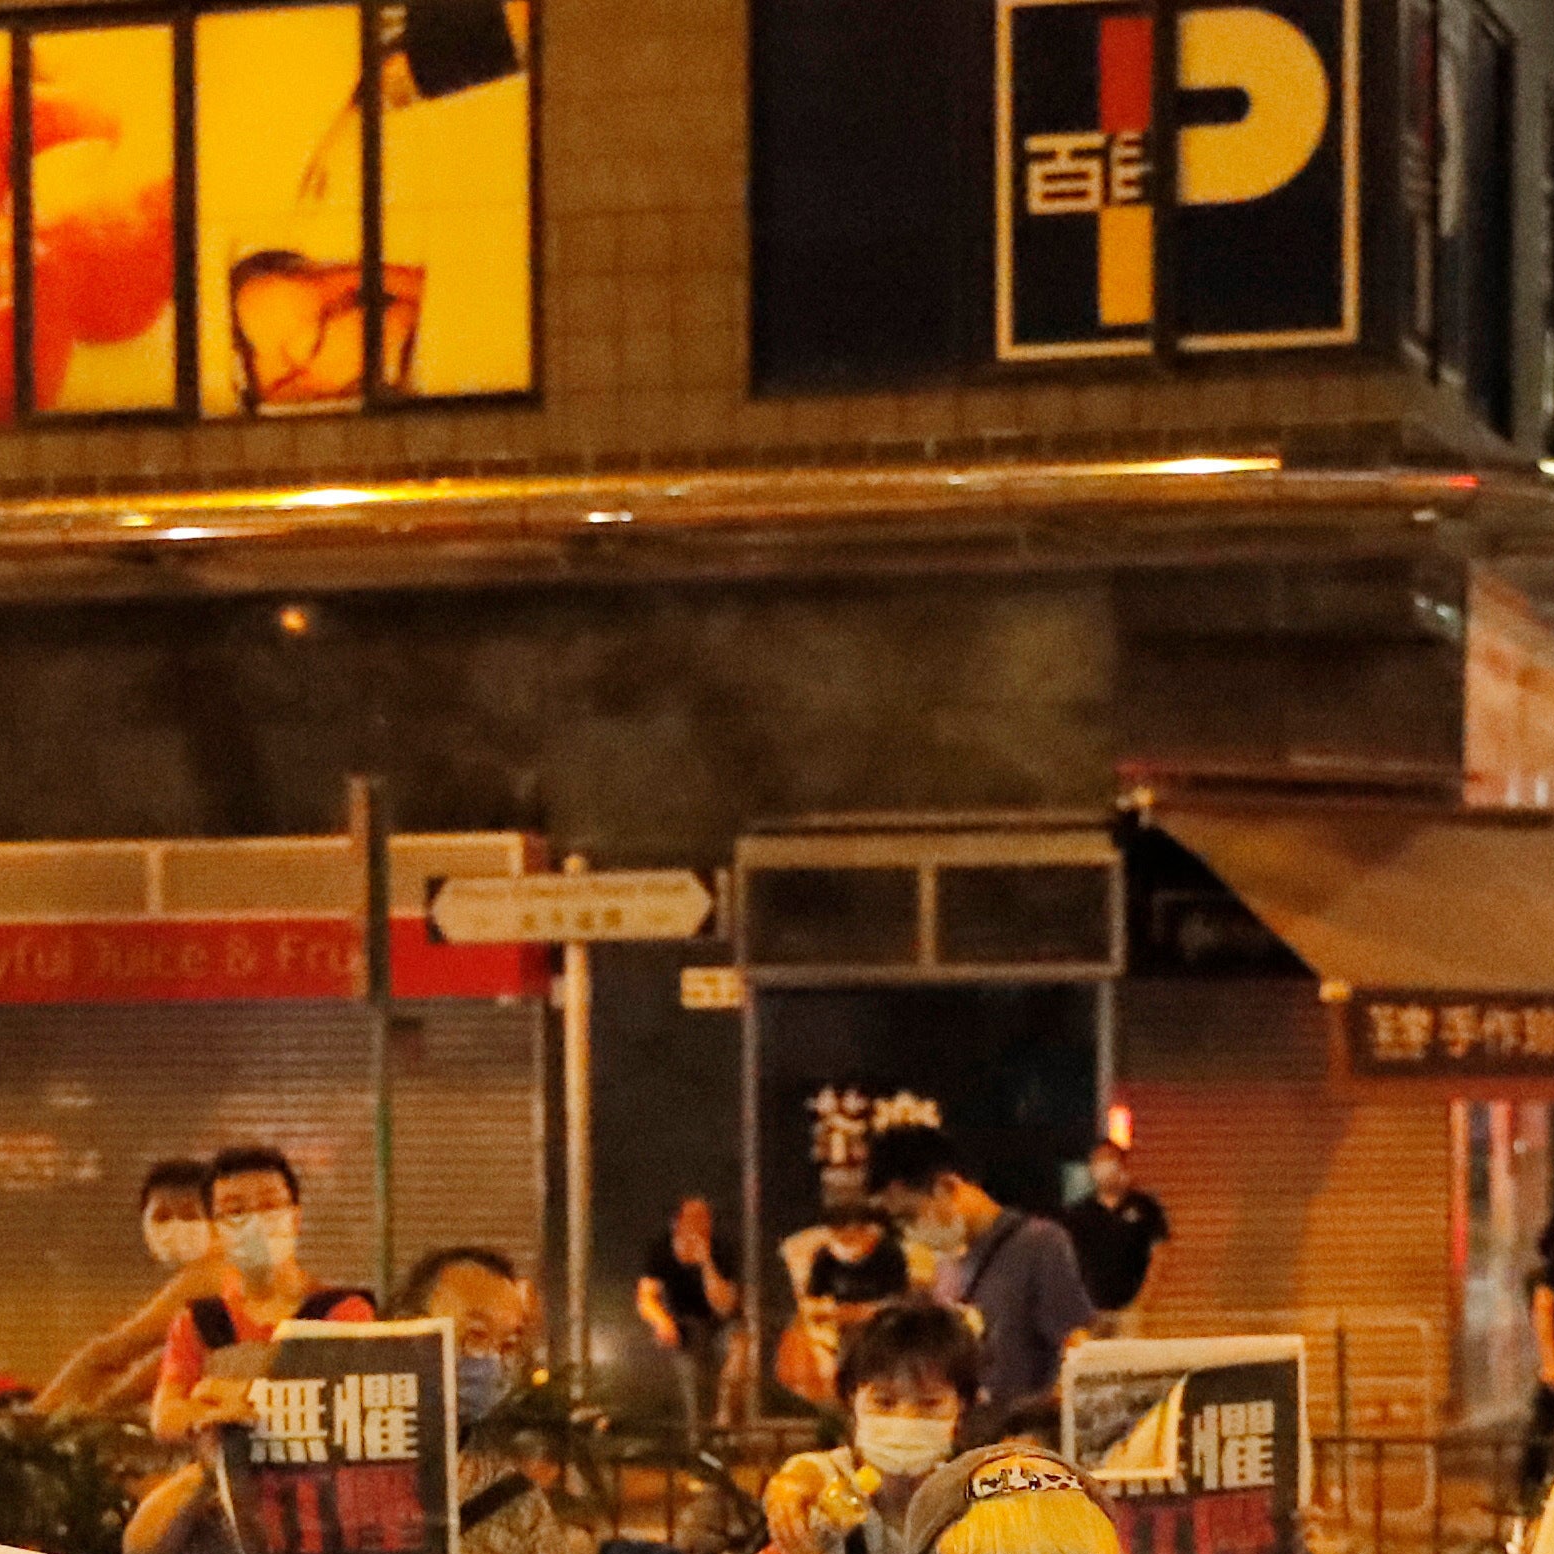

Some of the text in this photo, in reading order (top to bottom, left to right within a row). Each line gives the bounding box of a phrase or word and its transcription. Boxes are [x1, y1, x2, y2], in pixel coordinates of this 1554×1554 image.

[94, 933, 210, 980] Juice
[277, 933, 357, 980] Fru
[248, 1372, 420, 1465] 無懼
[1109, 1399, 1276, 1498] 懼
